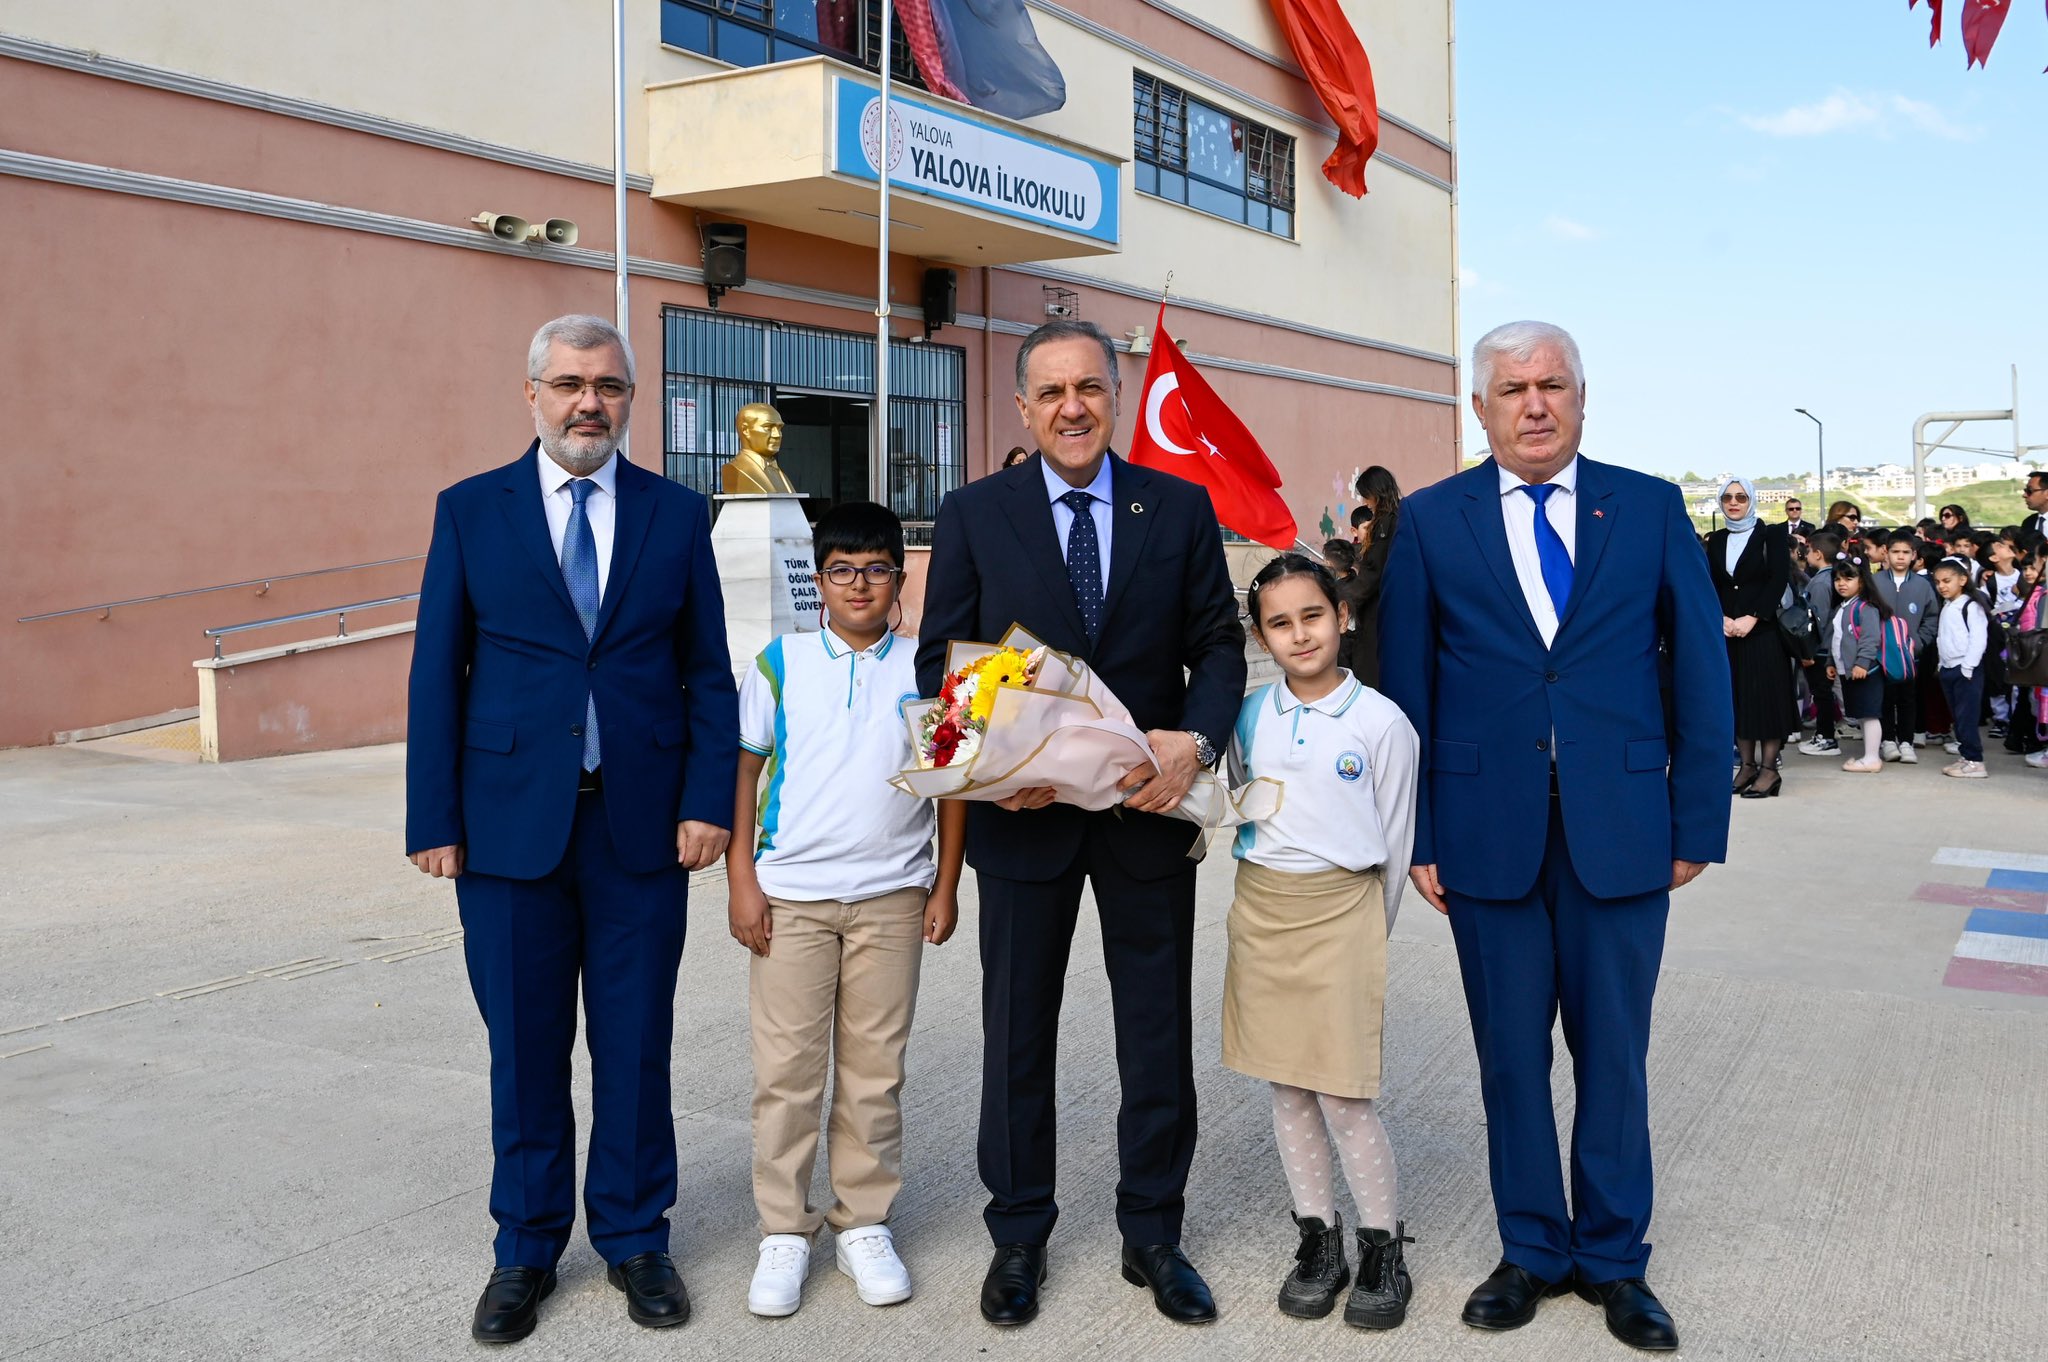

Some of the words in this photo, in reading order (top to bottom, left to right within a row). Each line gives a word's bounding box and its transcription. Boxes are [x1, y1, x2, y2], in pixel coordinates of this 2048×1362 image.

[910, 119, 953, 149] YALOVA
[910, 146, 992, 197] YALOVA
[997, 165, 1086, 221] İLKOKULU
[784, 558, 810, 569] TÜRK
[788, 573, 814, 584] ÖĞÜN
[791, 587, 817, 599] ÇALIŞ
